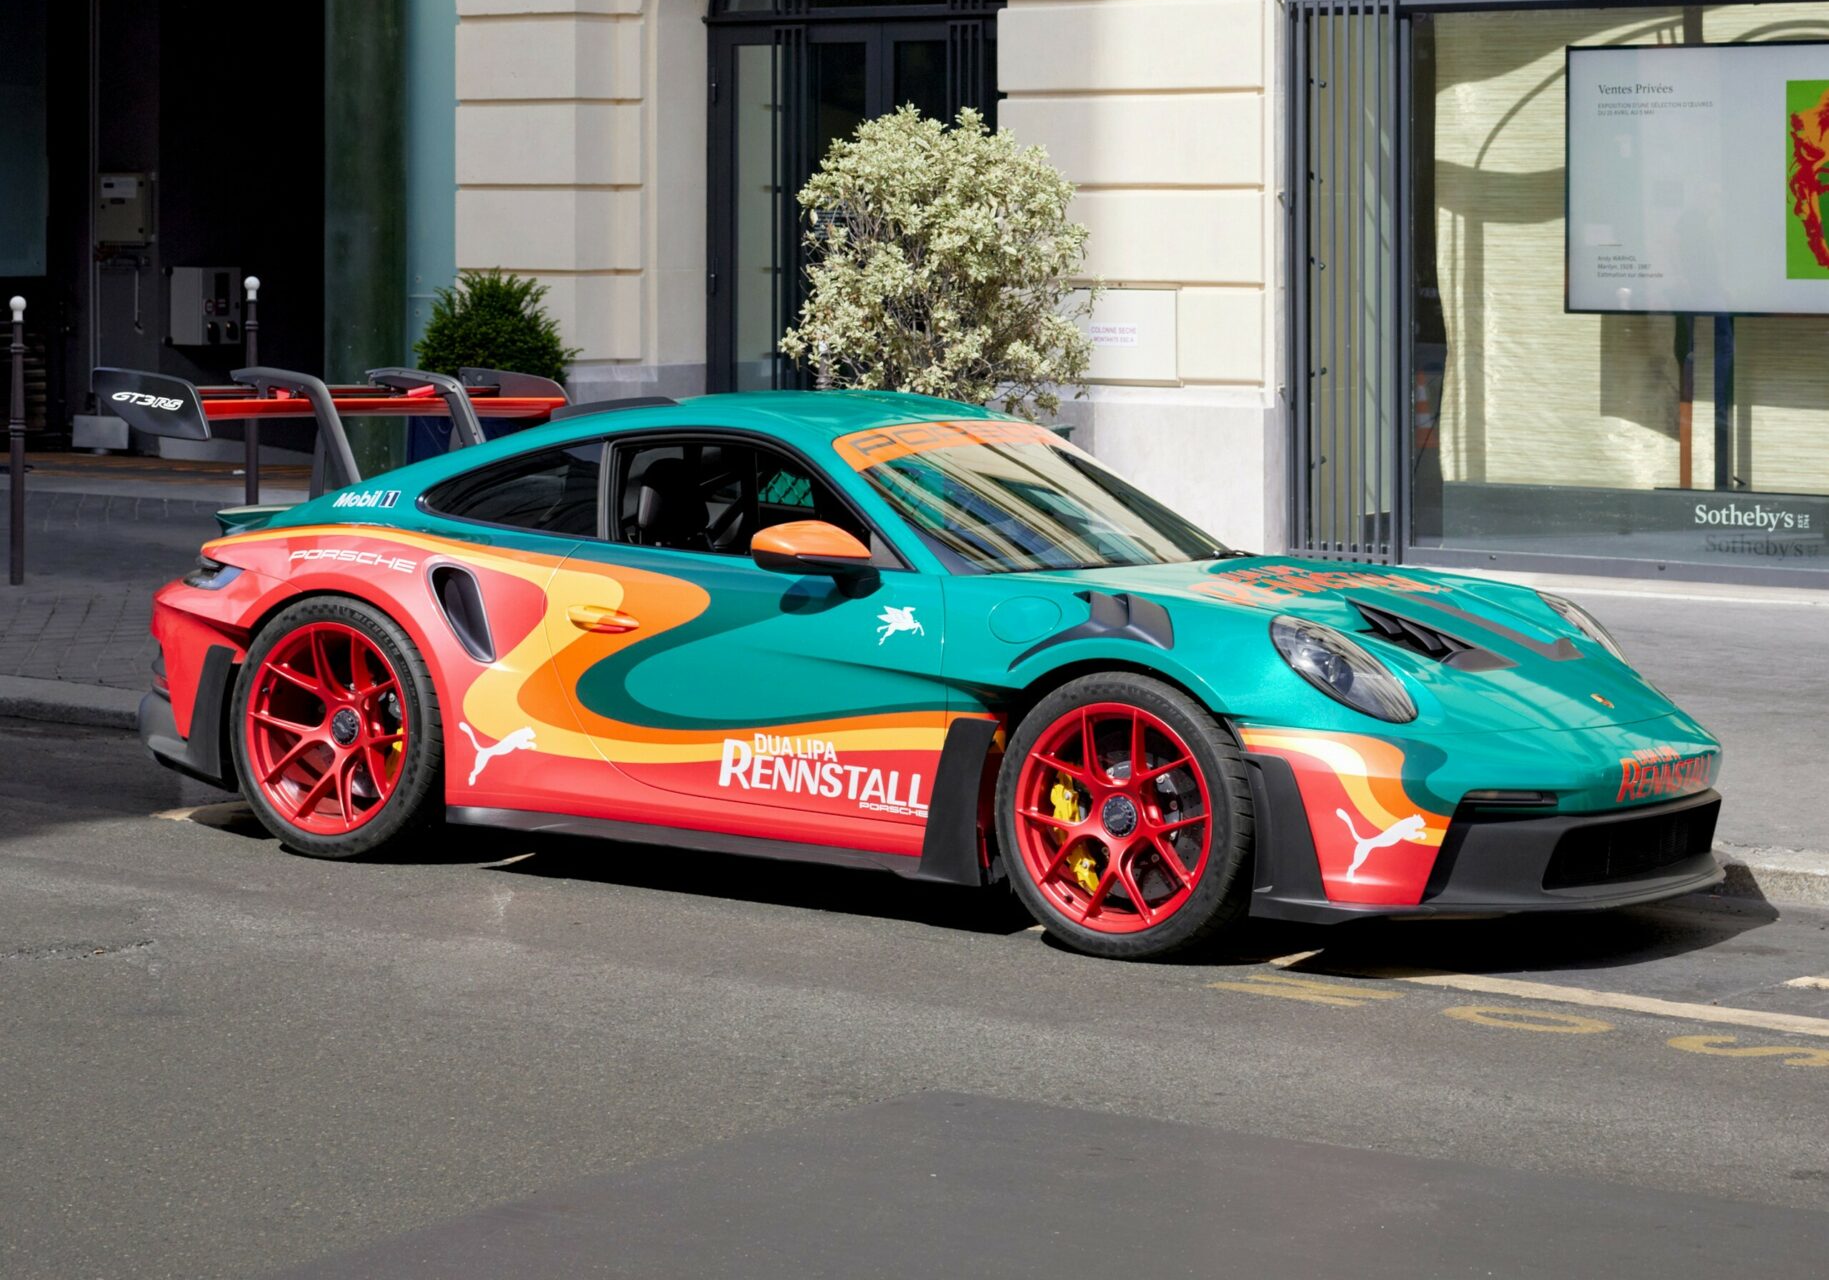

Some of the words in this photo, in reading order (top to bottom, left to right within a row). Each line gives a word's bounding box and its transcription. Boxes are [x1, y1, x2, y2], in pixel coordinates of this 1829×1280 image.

[1597, 84, 1633, 95] Ventes
[1636, 82, 1674, 94] Privées
[332, 490, 383, 508] Mobil
[1694, 503, 1795, 532] Sotheby's
[288, 549, 417, 574] PORSCHE
[754, 733, 794, 757] DUA
[796, 738, 838, 762] LIPA
[718, 738, 929, 809] RENNSTALL
[859, 801, 929, 818] PORSCHE
